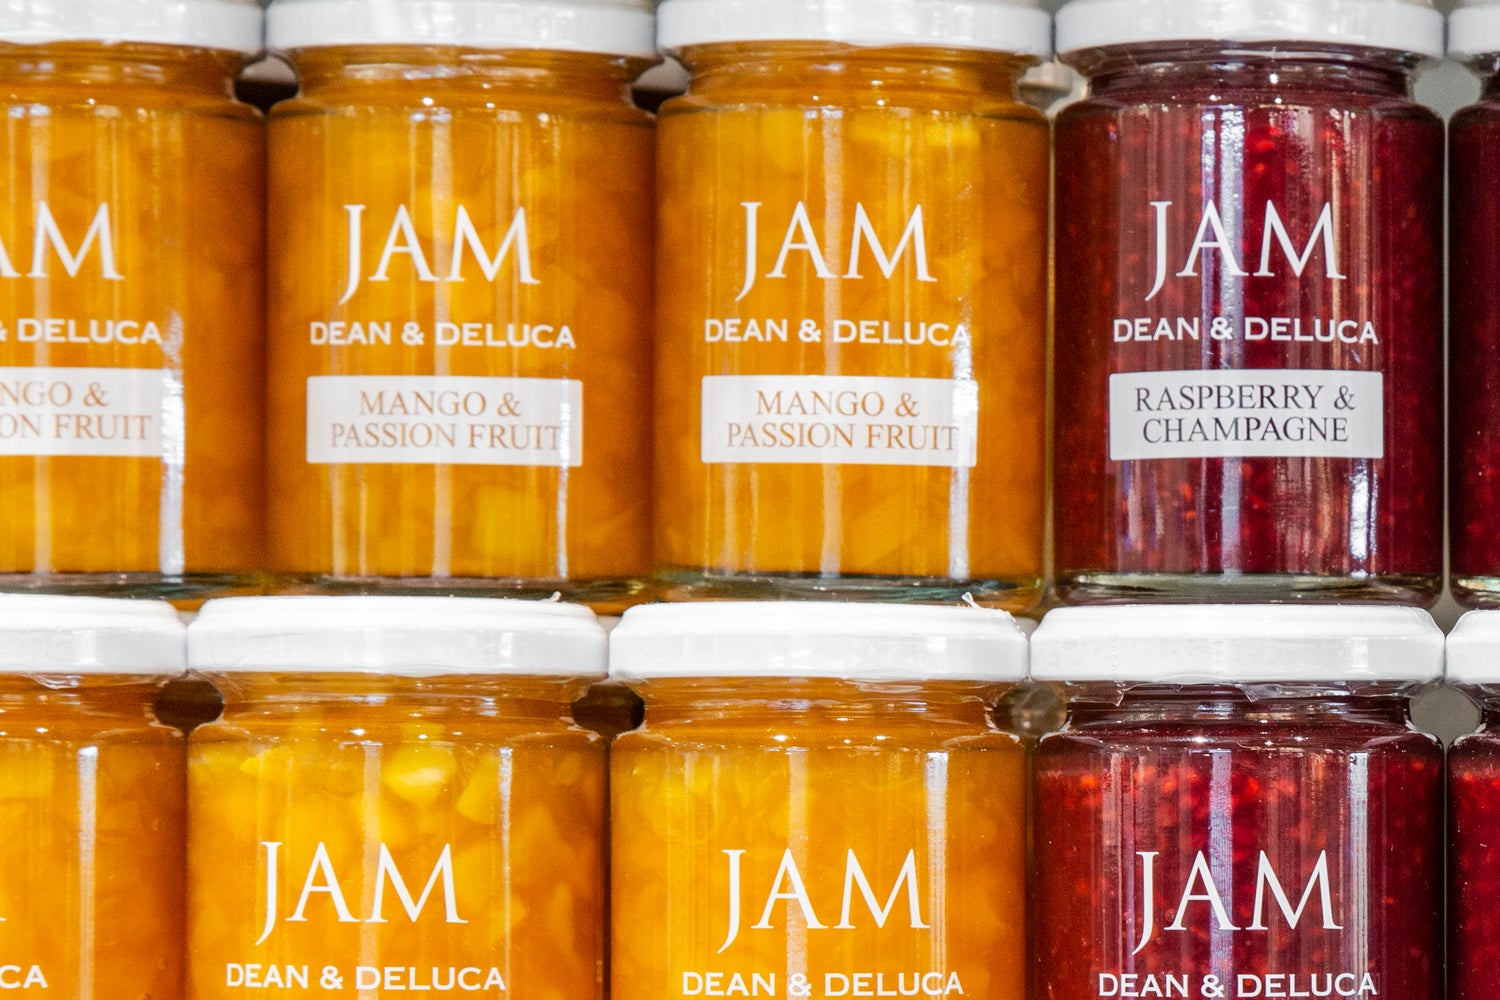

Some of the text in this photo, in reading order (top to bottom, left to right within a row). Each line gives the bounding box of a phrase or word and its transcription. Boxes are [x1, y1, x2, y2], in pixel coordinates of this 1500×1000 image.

[339, 204, 540, 305] JAM
[735, 201, 937, 300] JAM
[1145, 199, 1346, 300] JAM
[17, 319, 163, 344] DELUCA
[310, 322, 576, 348] DEAN & DELUCA
[705, 319, 969, 347] DEAN & DELUCA
[1114, 317, 1378, 344] DEAN & DELUCA
[0, 381, 107, 407] NGO &
[358, 391, 522, 417] MANGO &
[756, 391, 920, 417] MANGO &
[1135, 385, 1356, 412] RASPBERRY &
[53, 414, 152, 440] FRUIT
[330, 423, 561, 451] PASSION FRUIT
[726, 422, 959, 451] PASSION FRUIT
[1143, 417, 1349, 443] CHAMPAGNE
[255, 842, 469, 945] JAM
[717, 848, 931, 954] JAM
[1131, 850, 1343, 955] JAM
[226, 963, 506, 991] DEAN & DELUCA
[683, 971, 964, 997] DEAN & DELUCA
[1099, 973, 1377, 997] DEAN & DELUCA
